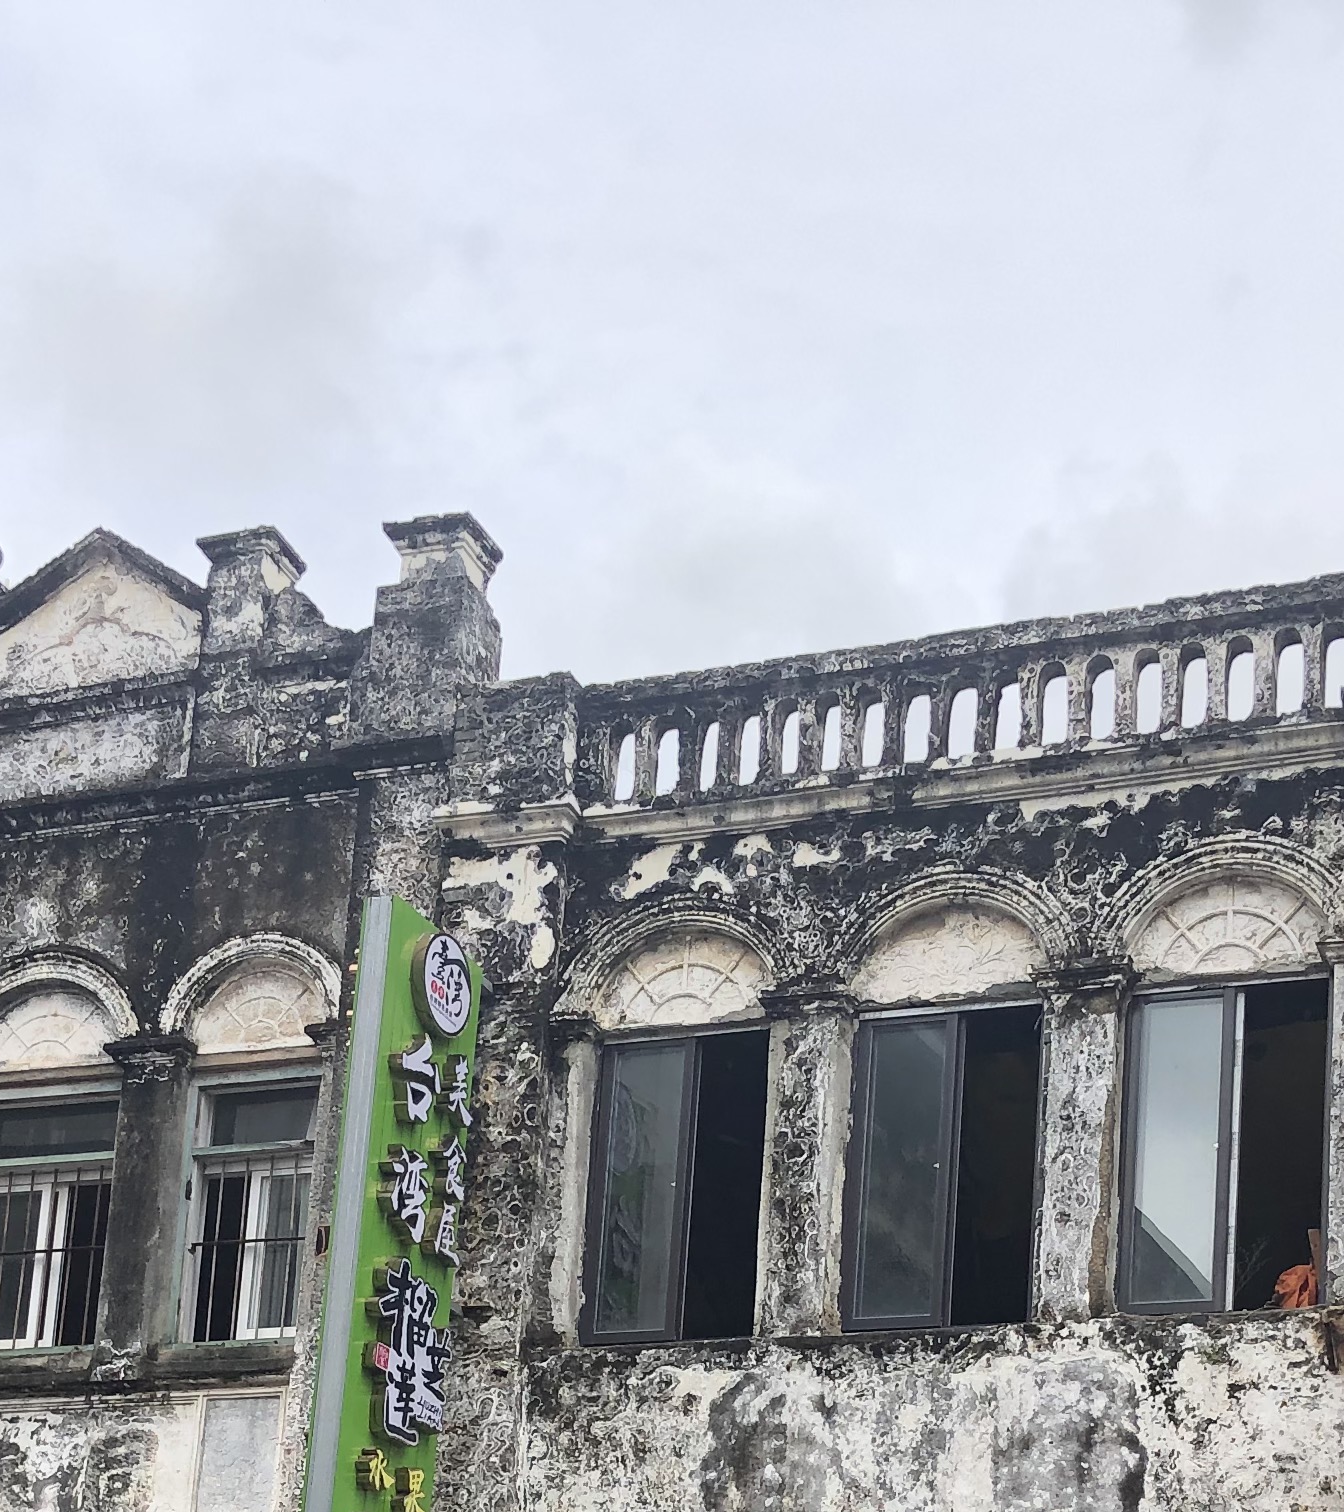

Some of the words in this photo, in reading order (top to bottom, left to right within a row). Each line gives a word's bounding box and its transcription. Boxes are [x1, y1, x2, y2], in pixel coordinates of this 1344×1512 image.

[391, 1032, 442, 1244] 台湾
[435, 1055, 474, 1266] 美食屋
